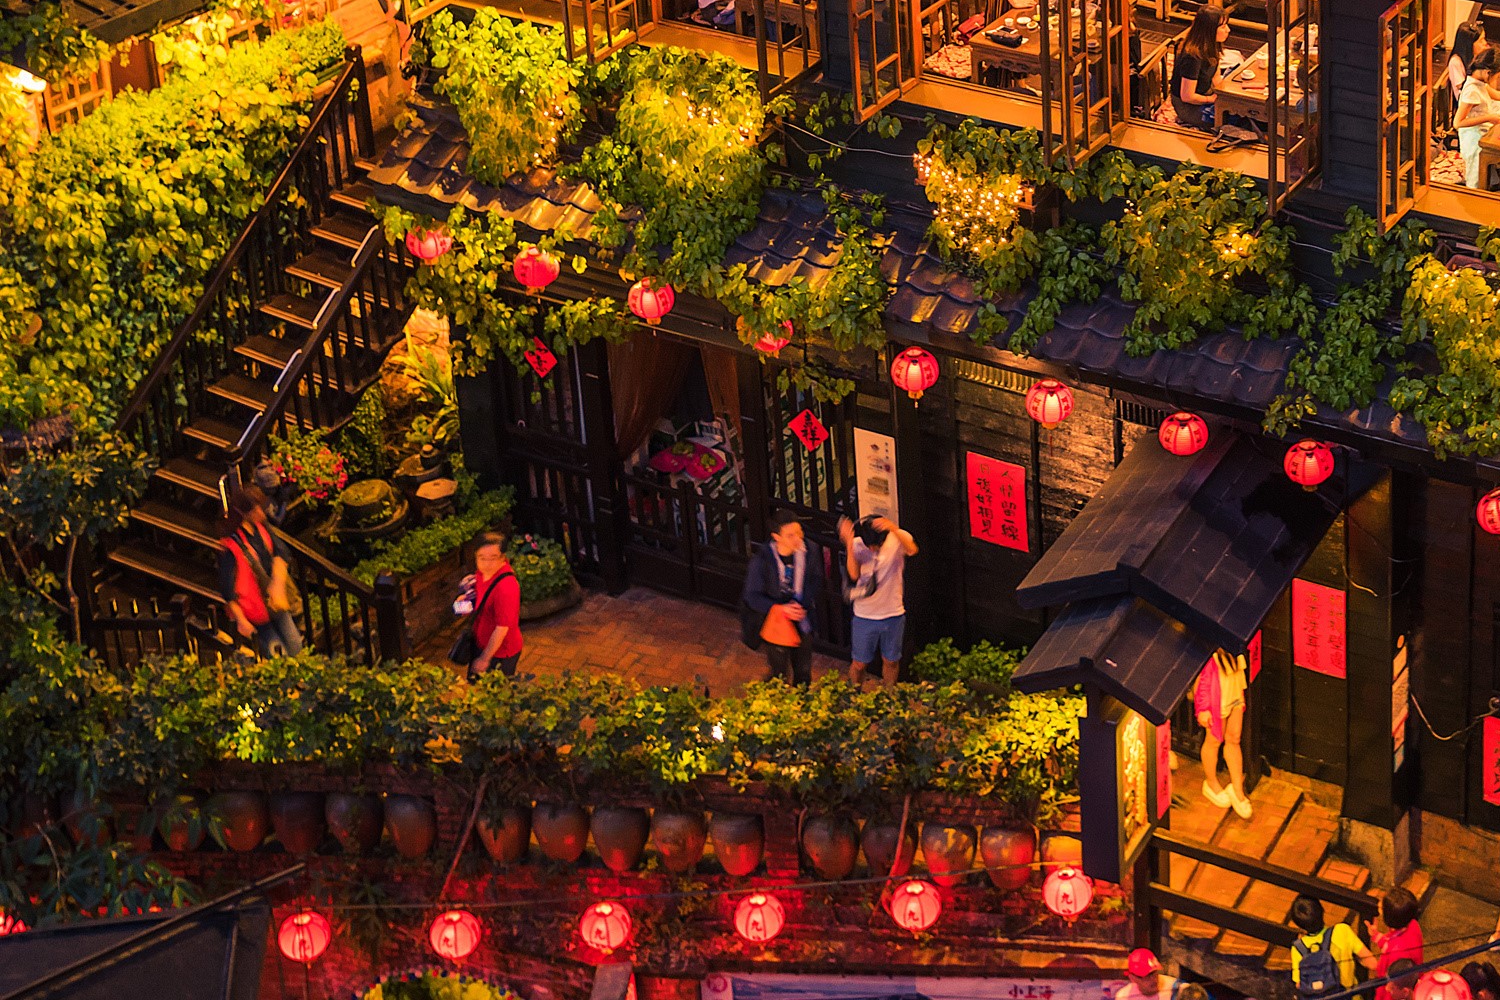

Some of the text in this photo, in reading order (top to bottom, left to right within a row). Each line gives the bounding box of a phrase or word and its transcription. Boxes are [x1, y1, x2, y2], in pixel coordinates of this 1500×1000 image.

[976, 463, 995, 537] 日後好相見
[1061, 892, 1073, 914] 九
[751, 920, 763, 940] 九
